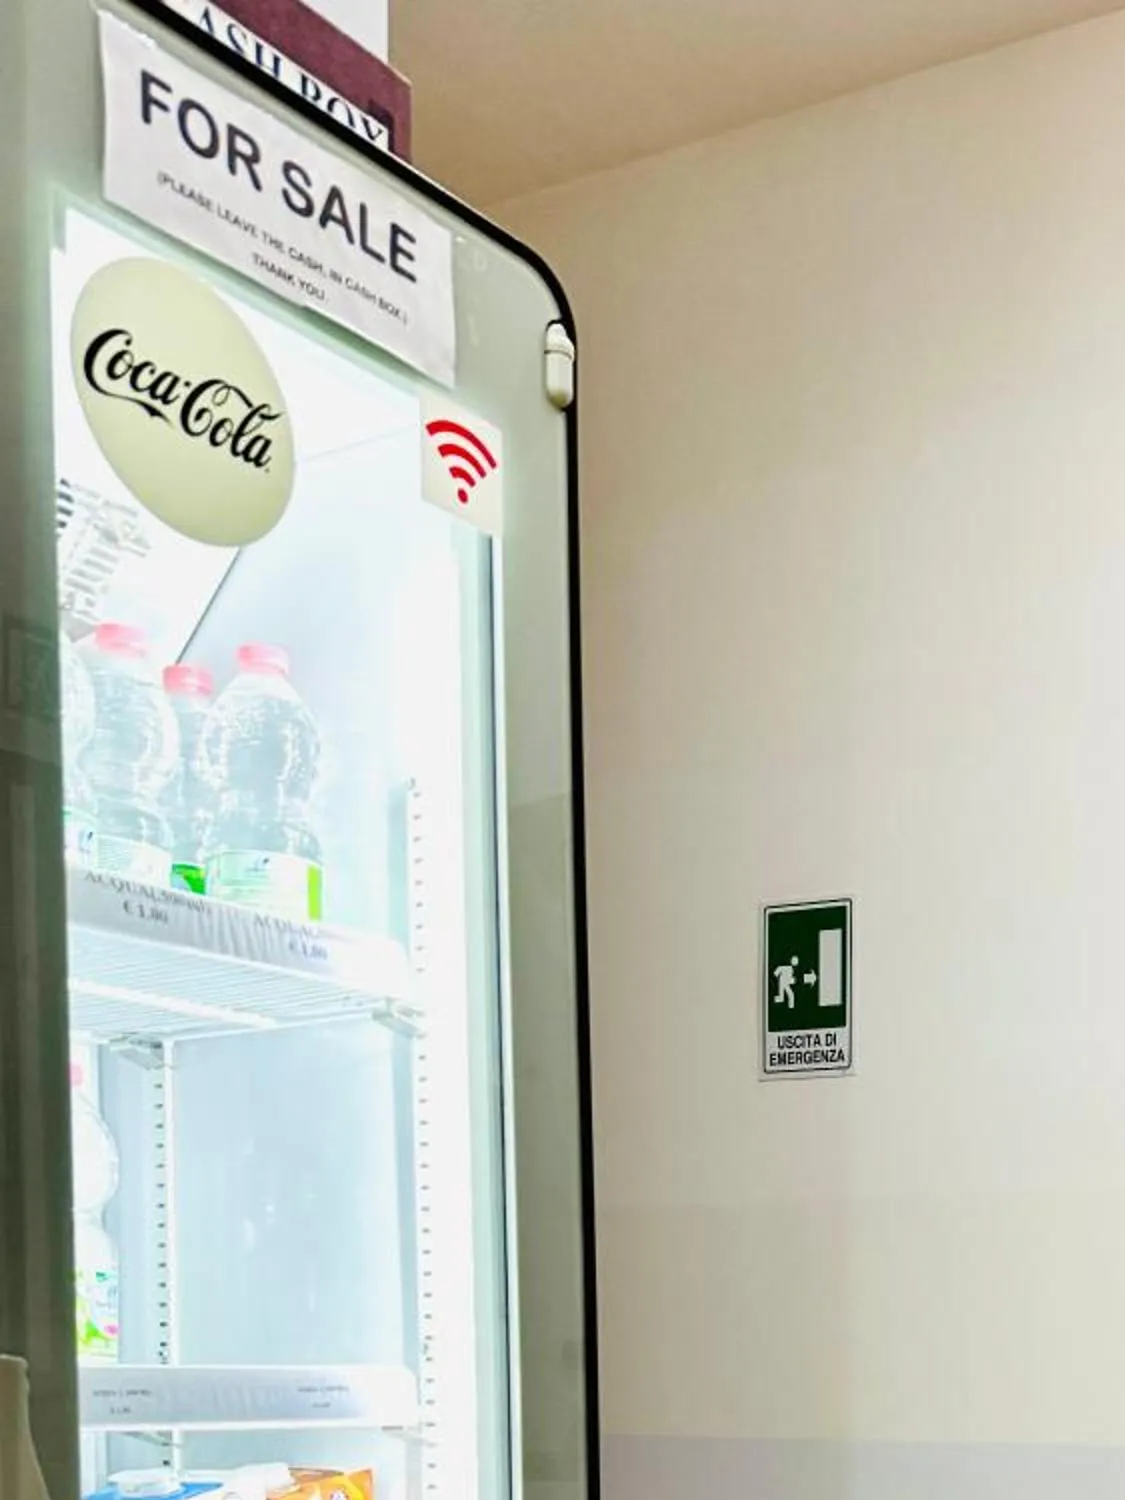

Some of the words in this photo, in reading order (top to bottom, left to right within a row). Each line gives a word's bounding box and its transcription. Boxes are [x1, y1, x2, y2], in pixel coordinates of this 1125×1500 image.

[197, 5, 285, 82] ASH
[140, 70, 263, 192] FOR
[280, 160, 418, 283] SALE
[217, 205, 259, 239] LEAVE
[262, 230, 285, 254] THE
[329, 270, 343, 286] IN
[345, 275, 377, 305] CASH
[252, 252, 296, 287] THANK
[84, 328, 285, 468] Coca-Cola
[769, 1050, 845, 1066] EMERGENZA
[778, 1034, 822, 1049] USCITA
[825, 1032, 837, 1046] DI
